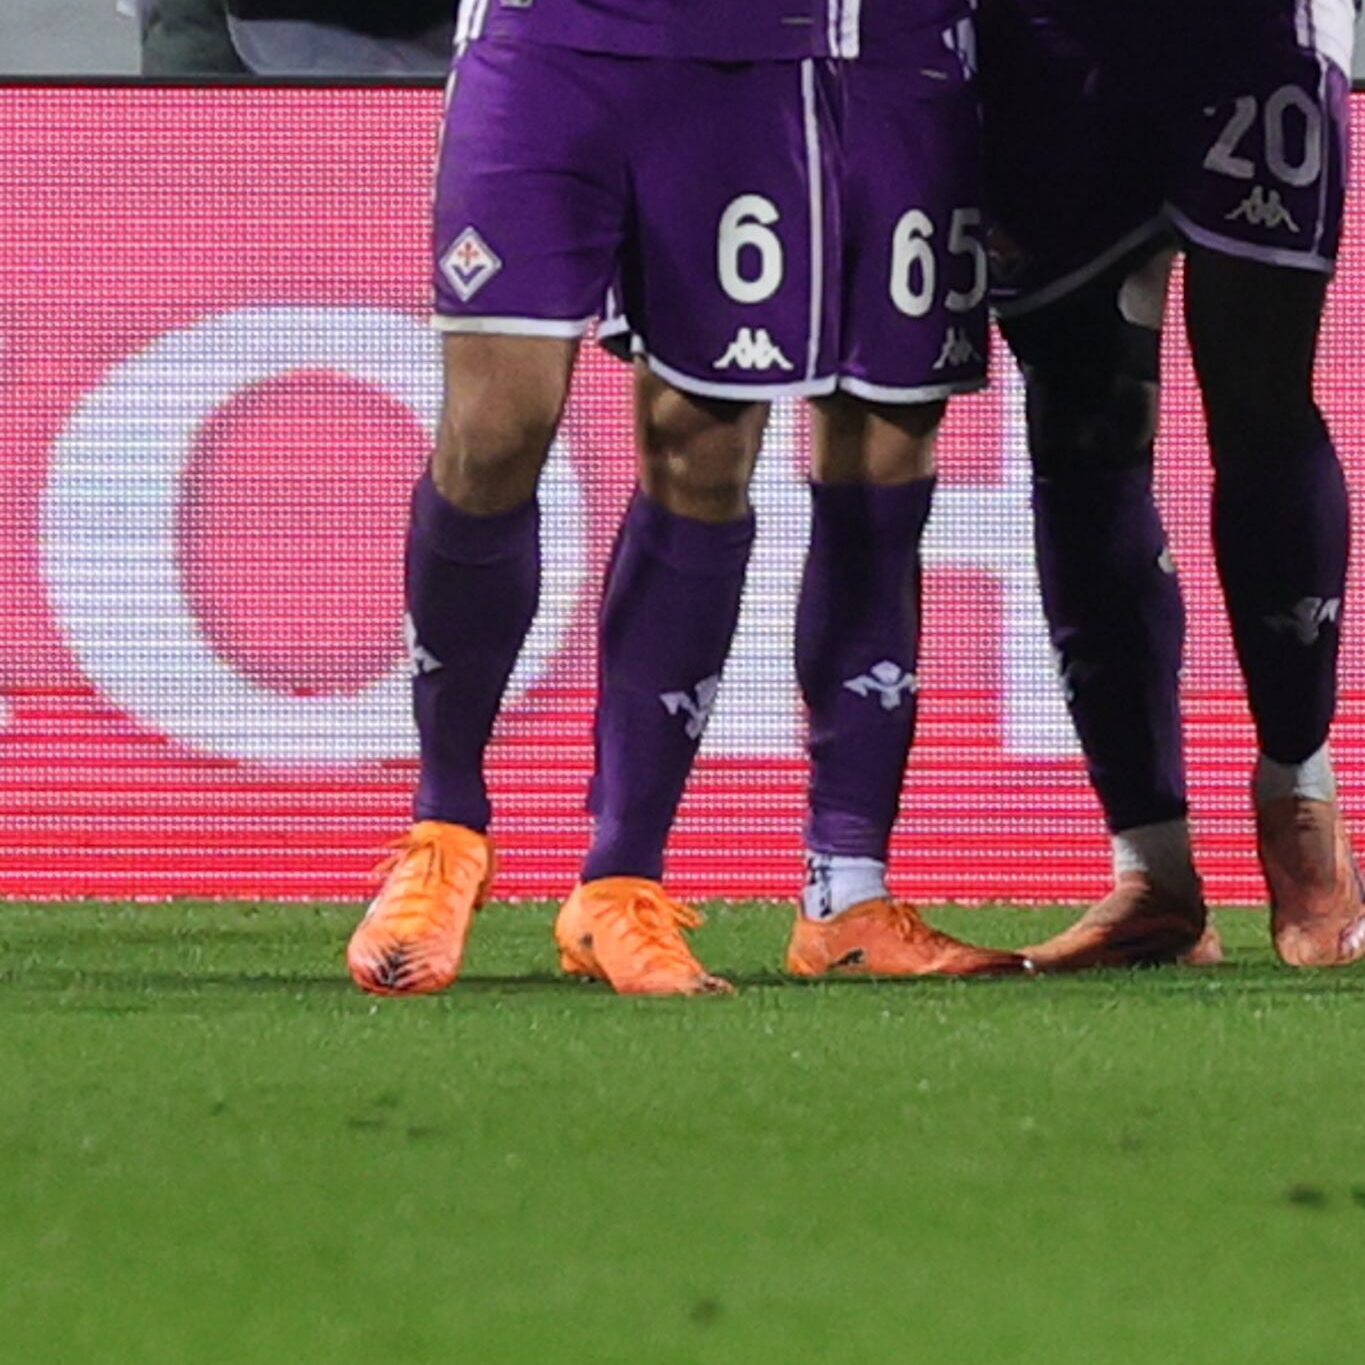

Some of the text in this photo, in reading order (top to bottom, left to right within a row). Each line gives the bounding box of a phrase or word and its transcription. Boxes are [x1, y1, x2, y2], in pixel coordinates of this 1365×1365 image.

[1202, 84, 1322, 187] 20
[716, 194, 783, 304] 6
[889, 208, 988, 317] 65
[0, 304, 1085, 772] OH
